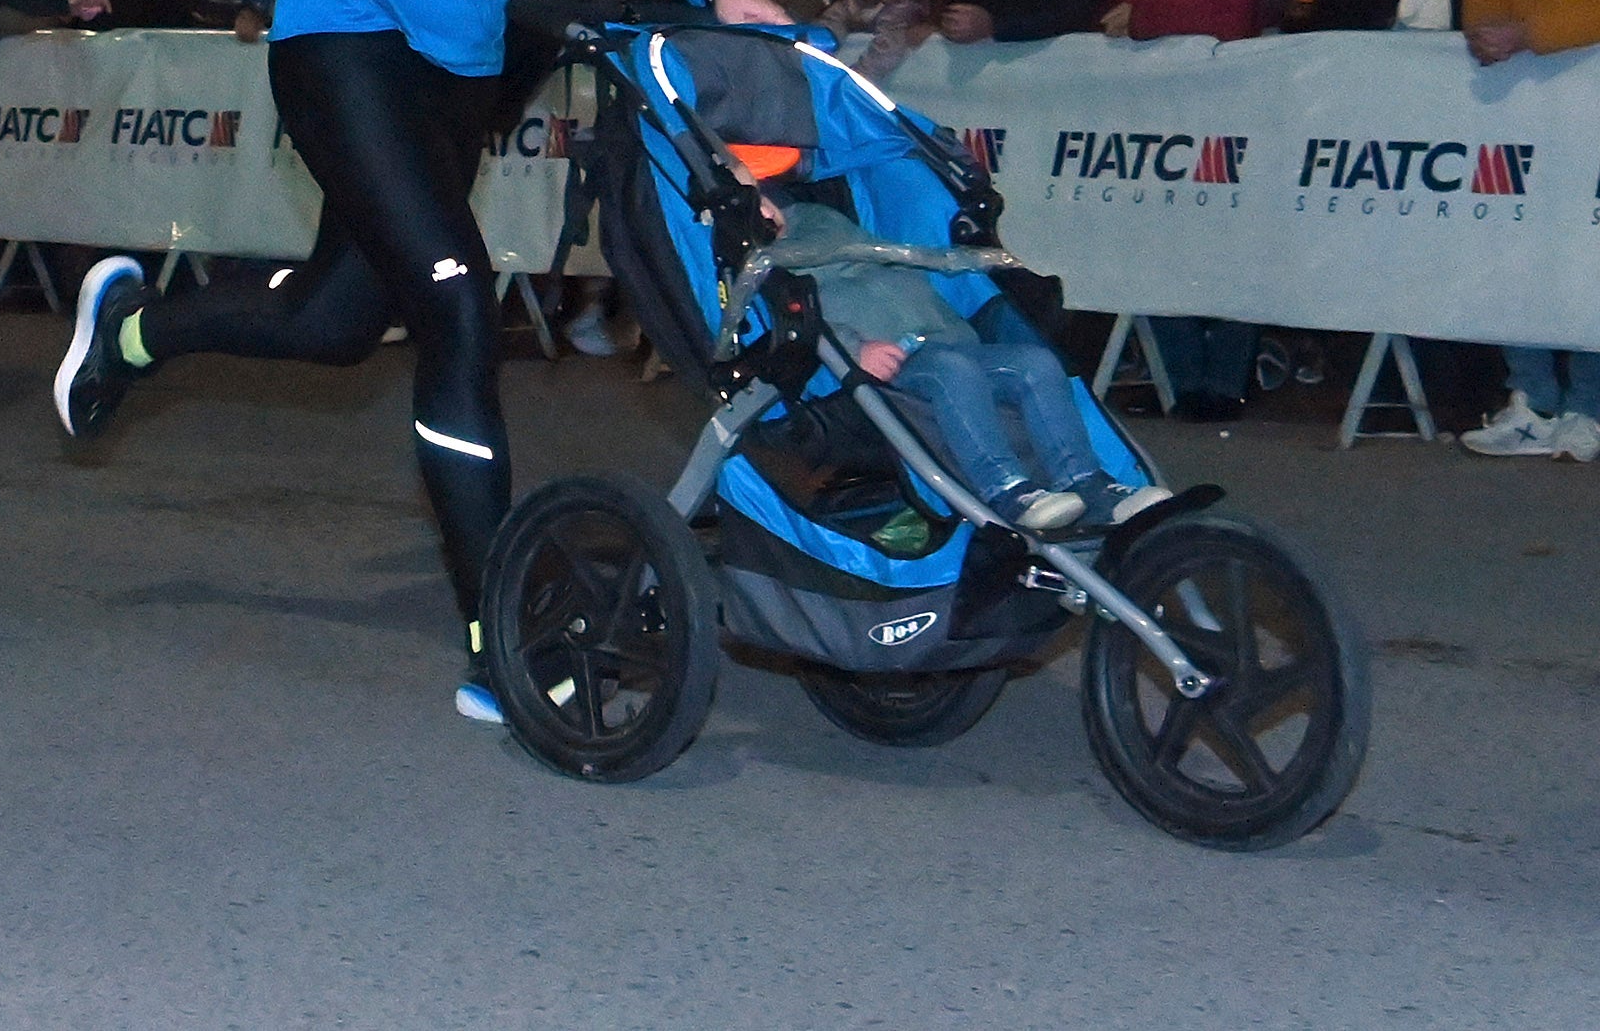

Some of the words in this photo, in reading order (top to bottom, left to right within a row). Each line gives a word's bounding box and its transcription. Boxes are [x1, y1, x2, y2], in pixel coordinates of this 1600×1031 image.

[111, 108, 209, 146] FIATC
[1051, 130, 1195, 182] FIATC
[1298, 138, 1467, 193] FIATC
[1044, 183, 1243, 210] SEGUROS
[1296, 195, 1526, 223] SEGUROS
